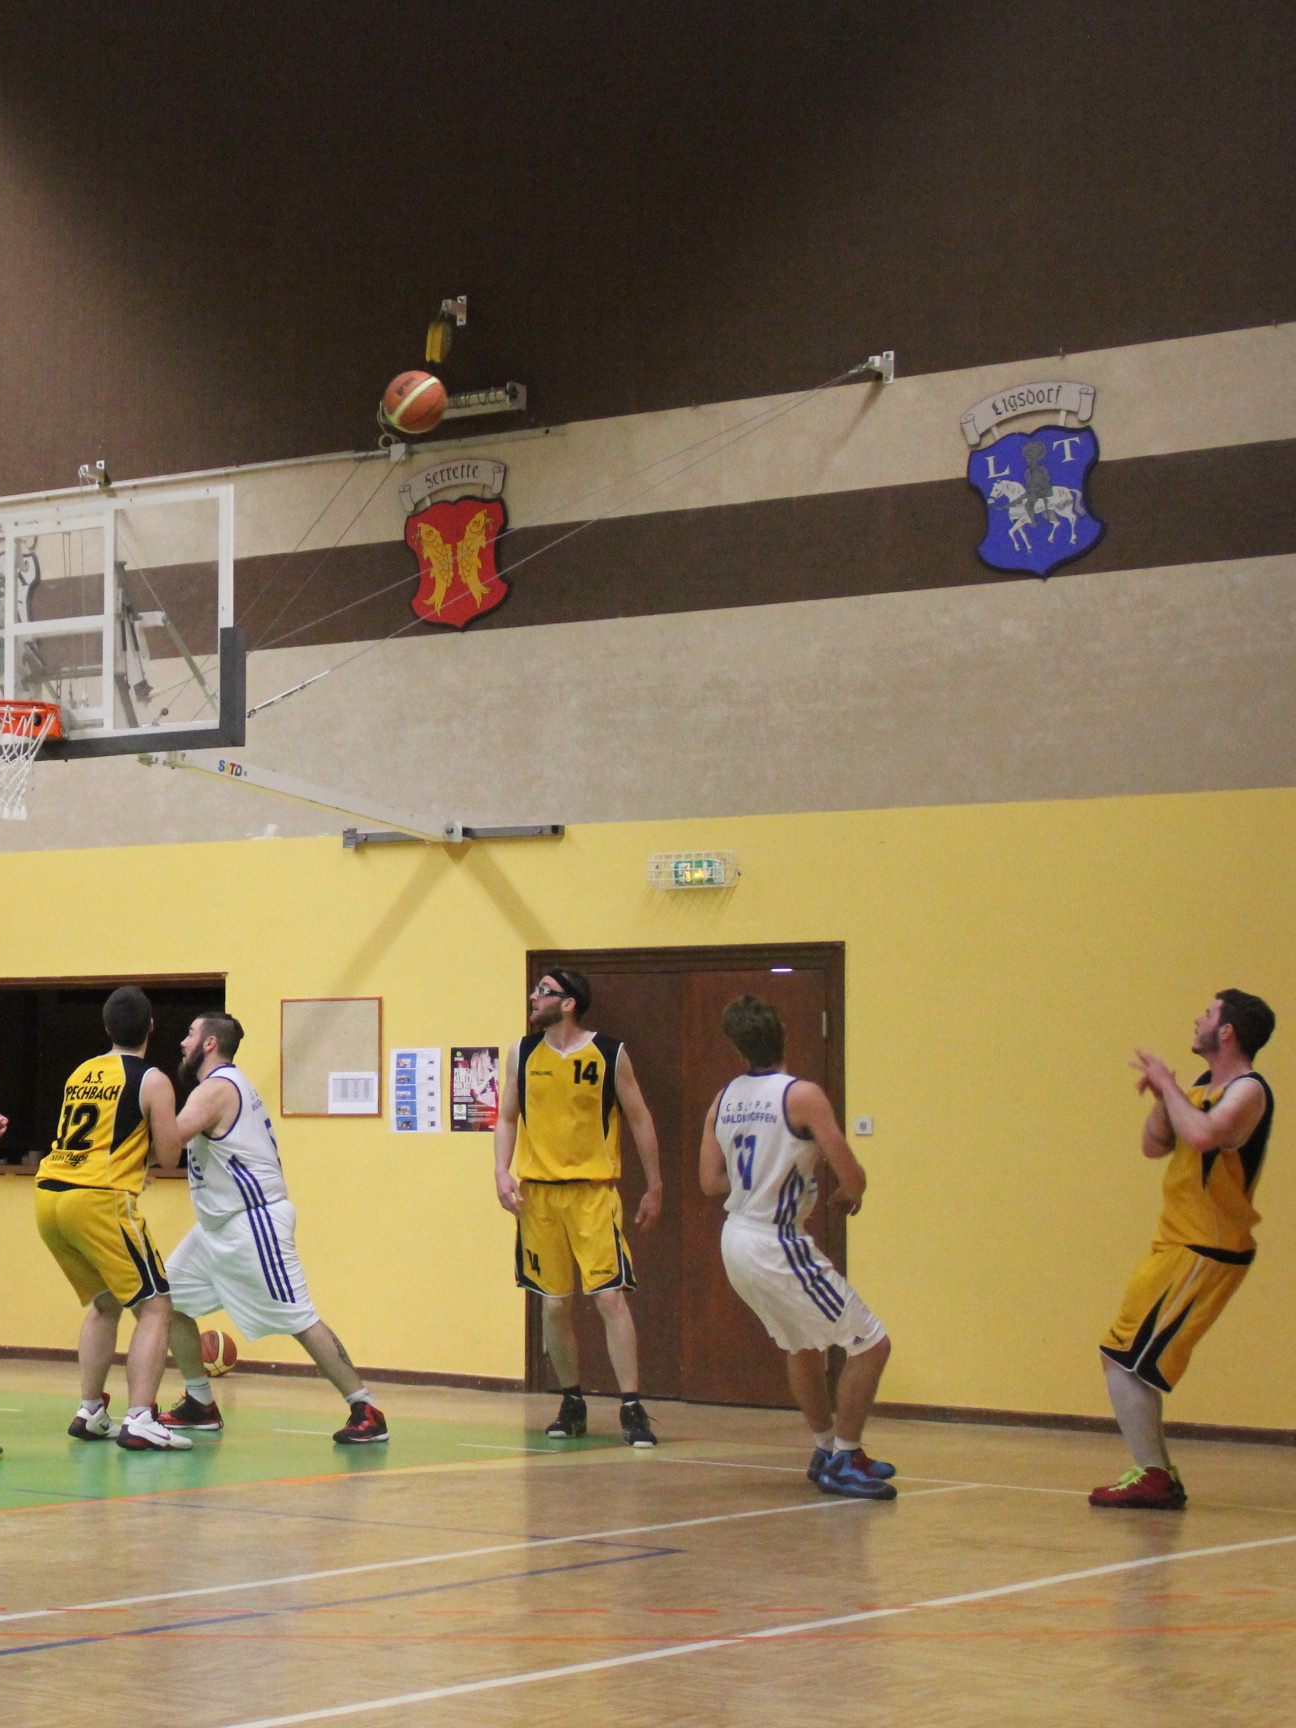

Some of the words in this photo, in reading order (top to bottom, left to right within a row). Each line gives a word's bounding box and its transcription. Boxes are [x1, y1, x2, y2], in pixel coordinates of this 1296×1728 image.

[984, 455, 1011, 479] L
[1052, 436, 1081, 463] T
[82, 1070, 104, 1084] A.S.
[573, 1059, 599, 1086] 14
[65, 1085, 122, 1101] PECHBACH
[56, 1102, 101, 1151] 12
